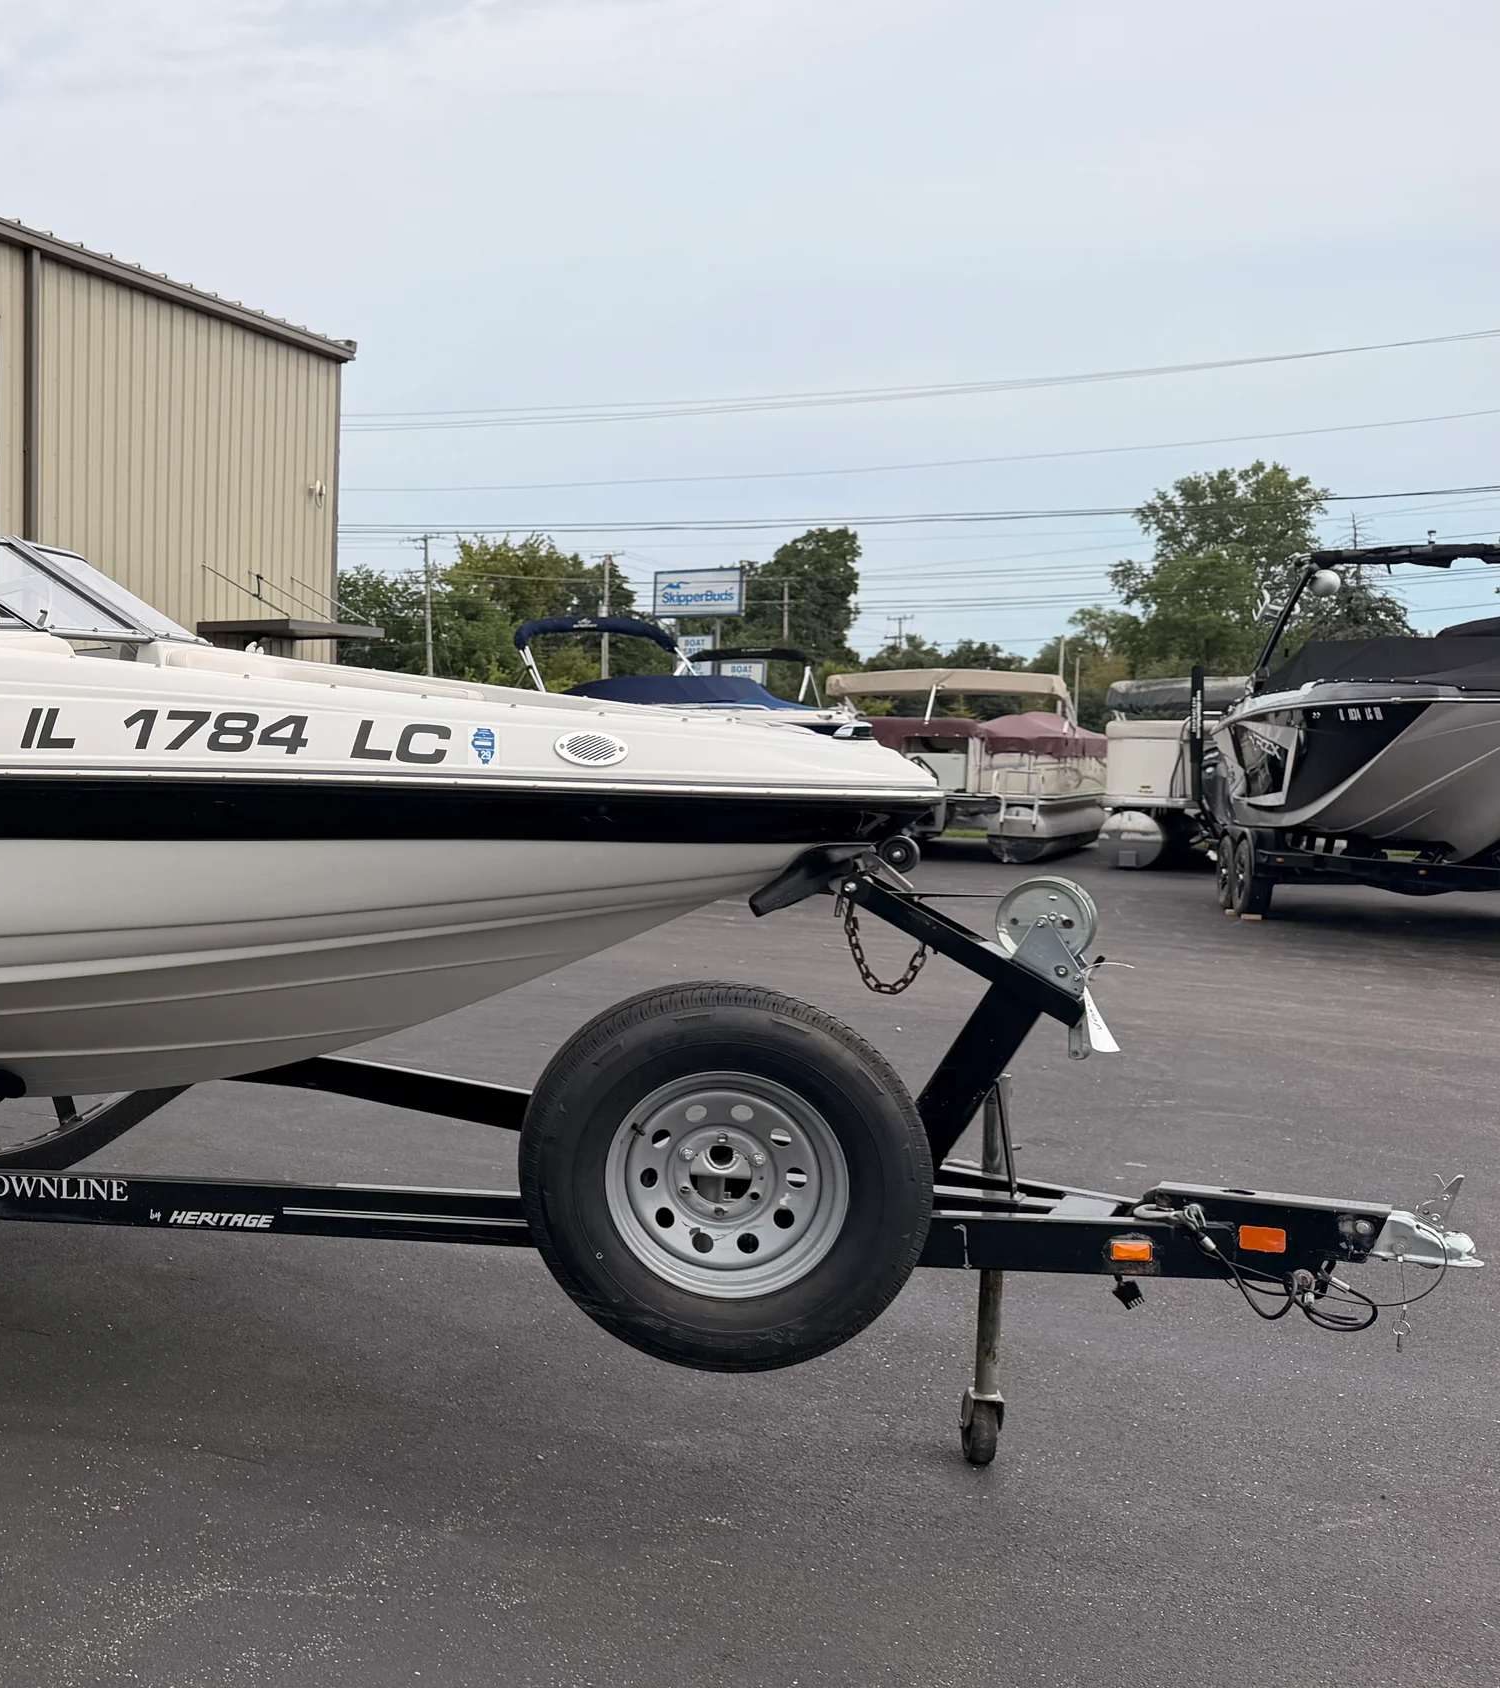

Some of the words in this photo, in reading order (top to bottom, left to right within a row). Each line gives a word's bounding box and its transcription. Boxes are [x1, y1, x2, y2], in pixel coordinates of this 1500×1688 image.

[684, 639, 705, 647] BOAT
[731, 665, 752, 673] BOAT
[20, 707, 76, 749] IL
[123, 709, 309, 755] 1784
[350, 720, 452, 764] LC
[480, 750, 491, 760] 29
[150, 1208, 162, 1222] by
[168, 1211, 275, 1228] HERITAGE
